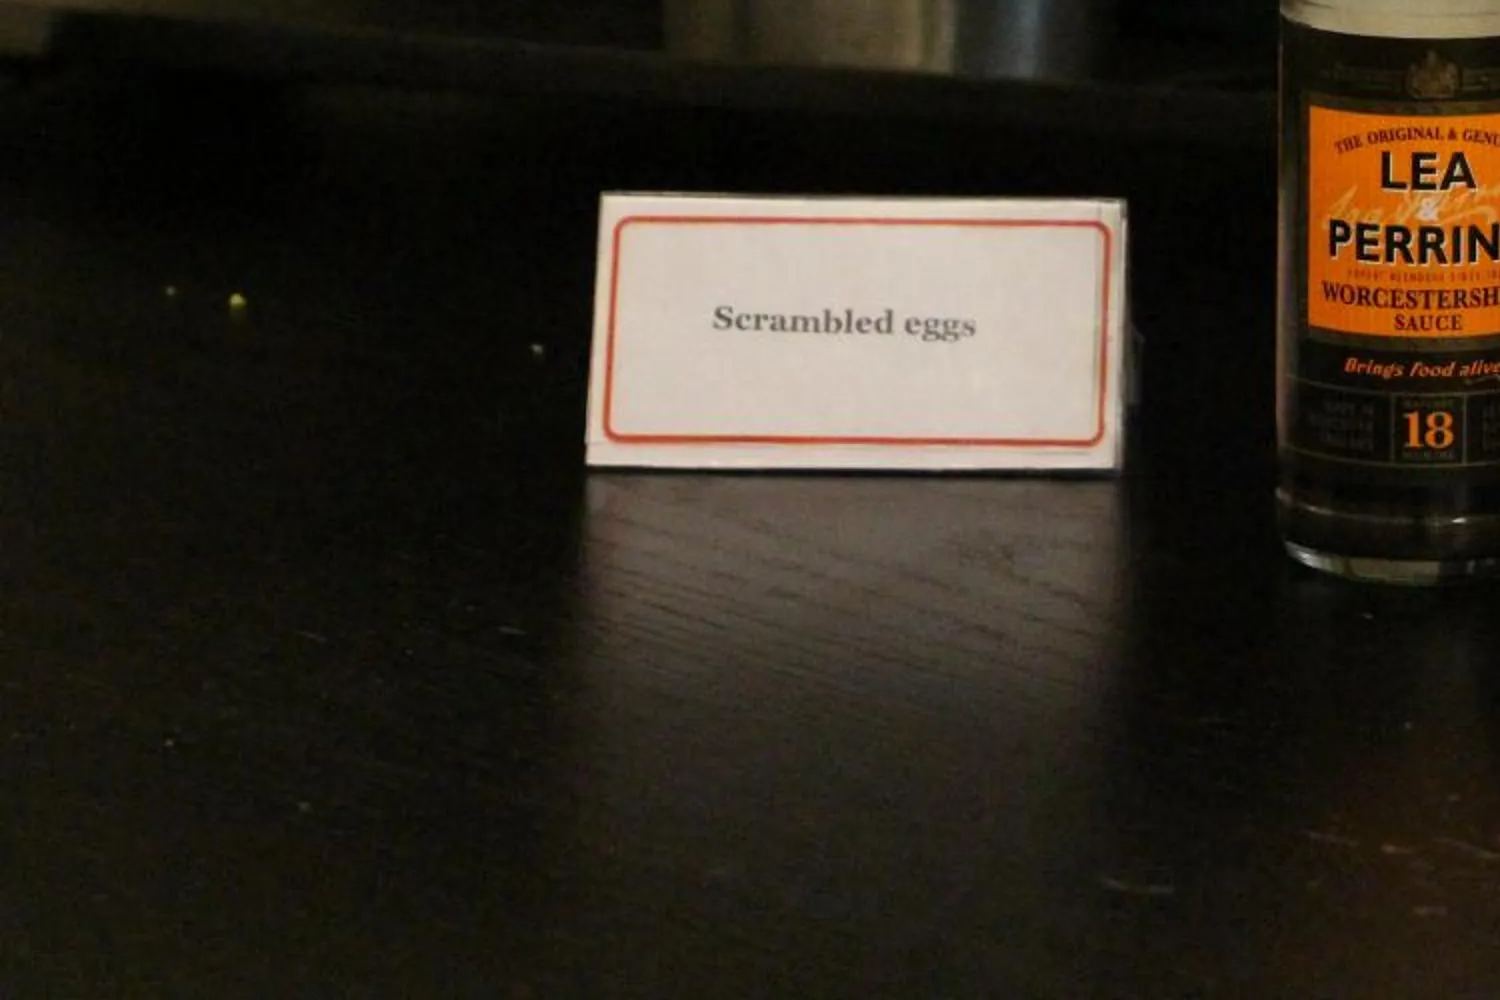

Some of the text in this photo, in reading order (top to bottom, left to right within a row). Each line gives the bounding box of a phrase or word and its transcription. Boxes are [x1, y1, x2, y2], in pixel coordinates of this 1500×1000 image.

[1334, 136, 1363, 155] THE
[1367, 127, 1444, 145] ORIGINAL
[1380, 150, 1477, 192] LEA
[712, 305, 977, 342] Scrambled eggs
[1394, 313, 1463, 332] SAUCE
[1344, 356, 1404, 379] Brings
[1410, 360, 1455, 378] food
[1403, 410, 1455, 450] 18
